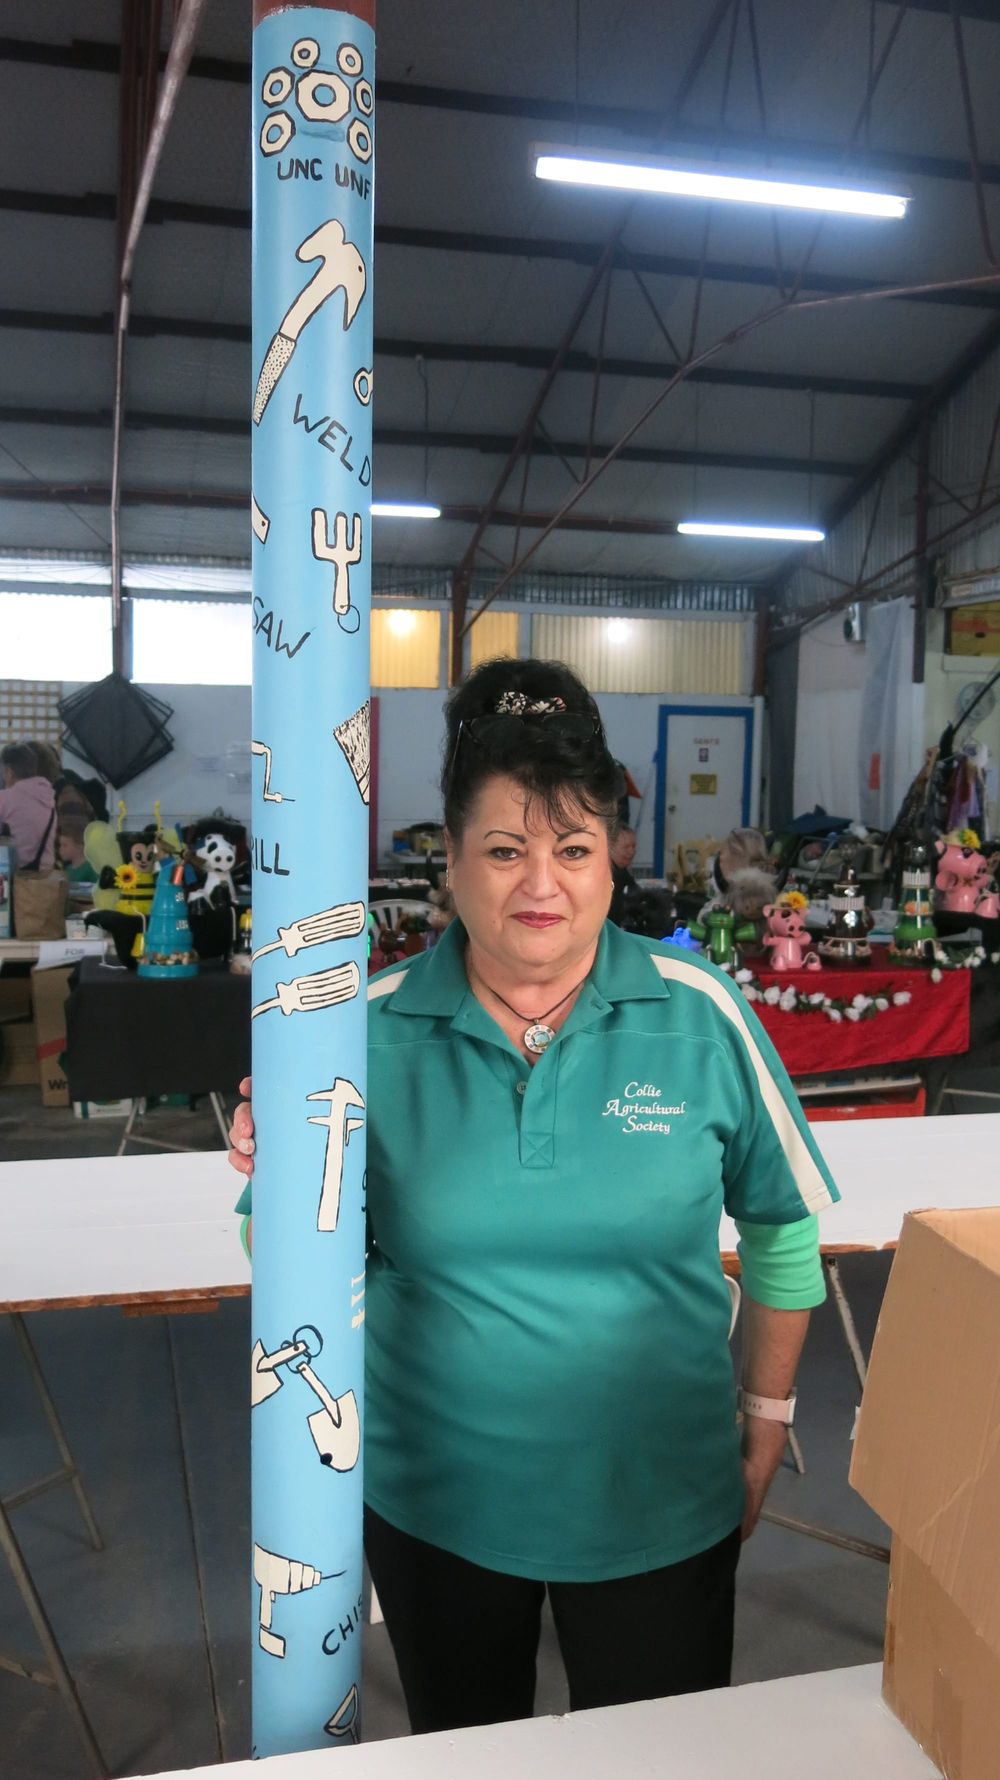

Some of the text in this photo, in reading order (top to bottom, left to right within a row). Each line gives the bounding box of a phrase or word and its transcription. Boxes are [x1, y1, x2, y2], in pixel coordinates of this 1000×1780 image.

[277, 158, 371, 200] UNC UNF
[293, 393, 371, 487] WELD
[253, 596, 311, 659] SAW
[624, 1081, 662, 1098] Collie
[602, 1099, 686, 1117] Agricultural
[622, 1115, 671, 1135] Society
